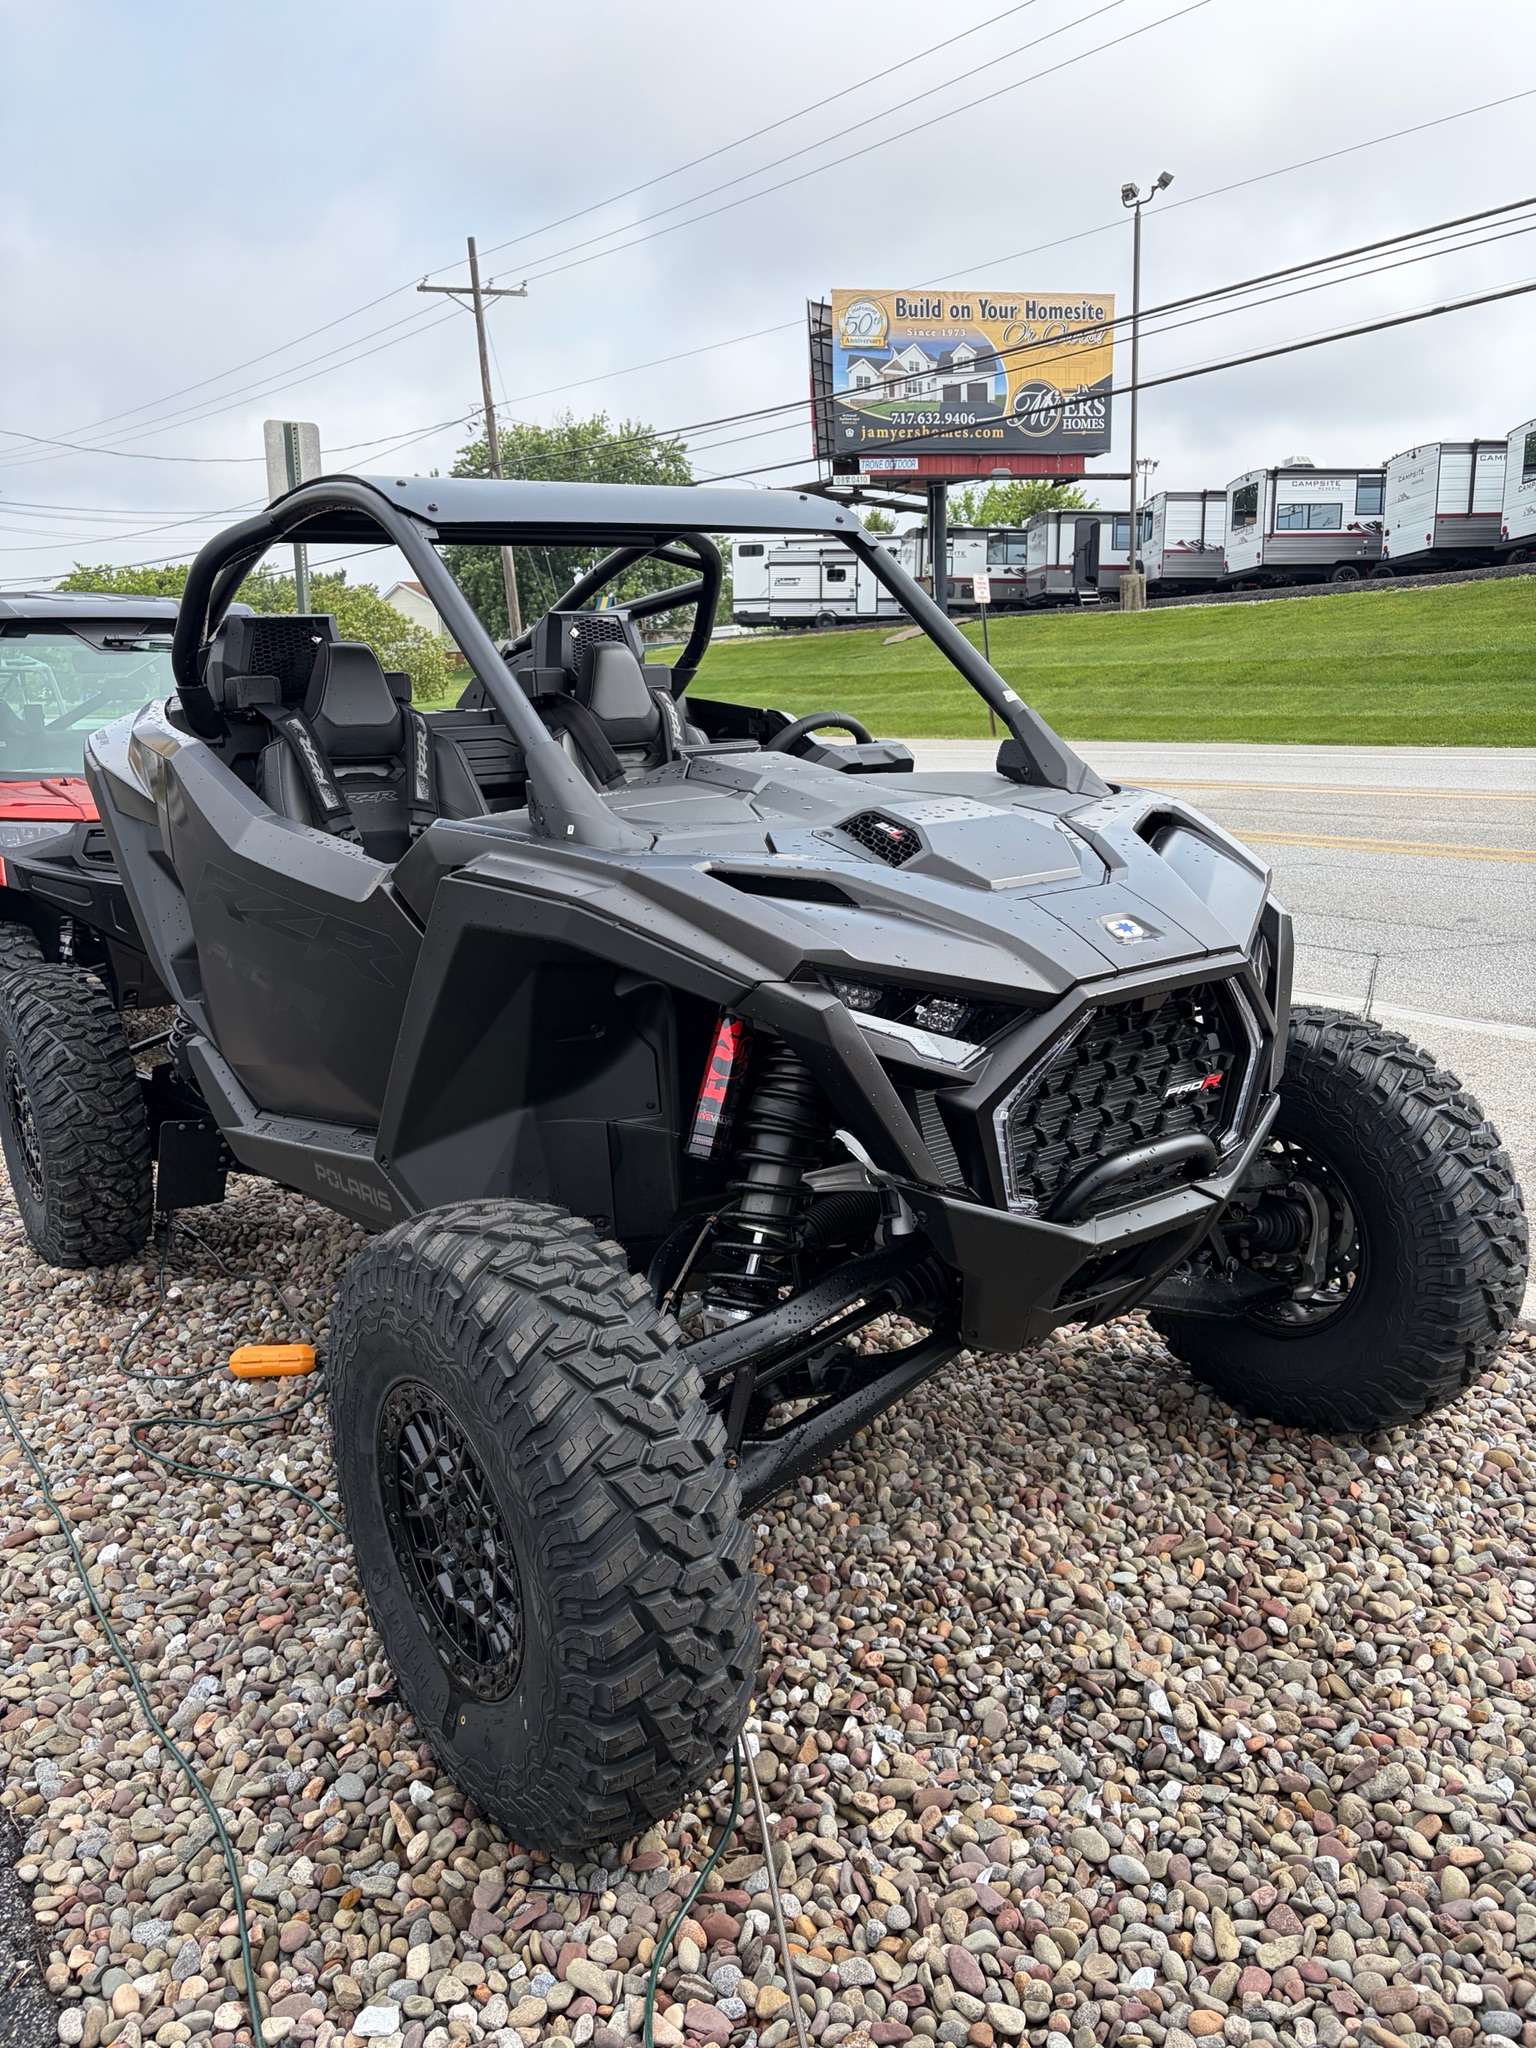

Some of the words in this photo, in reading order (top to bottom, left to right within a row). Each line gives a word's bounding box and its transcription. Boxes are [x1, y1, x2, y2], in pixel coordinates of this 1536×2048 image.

[895, 297, 942, 319] Build
[949, 303, 971, 319] on
[978, 299, 1018, 320] Your
[1025, 300, 1105, 320] Homesite
[846, 313, 883, 336] 50th
[907, 328, 936, 337] Since
[942, 328, 967, 337] 1973
[1003, 320, 1039, 346] Or
[845, 337, 882, 346] Anniversary
[1076, 384, 1089, 394] JA
[891, 412, 976, 426] 717.632.9406
[1062, 418, 1105, 430] HOMES
[861, 425, 1004, 442] jamyershomes.com
[861, 460, 885, 470] TRONE
[1398, 467, 1425, 483] CAMPSITE
[299, 736, 329, 785] RZR
[416, 730, 429, 780] RZR
[344, 790, 399, 804] RZR
[194, 860, 404, 988] RZR
[698, 1018, 746, 1104] FOX
[313, 1162, 392, 1212] POLARIS
